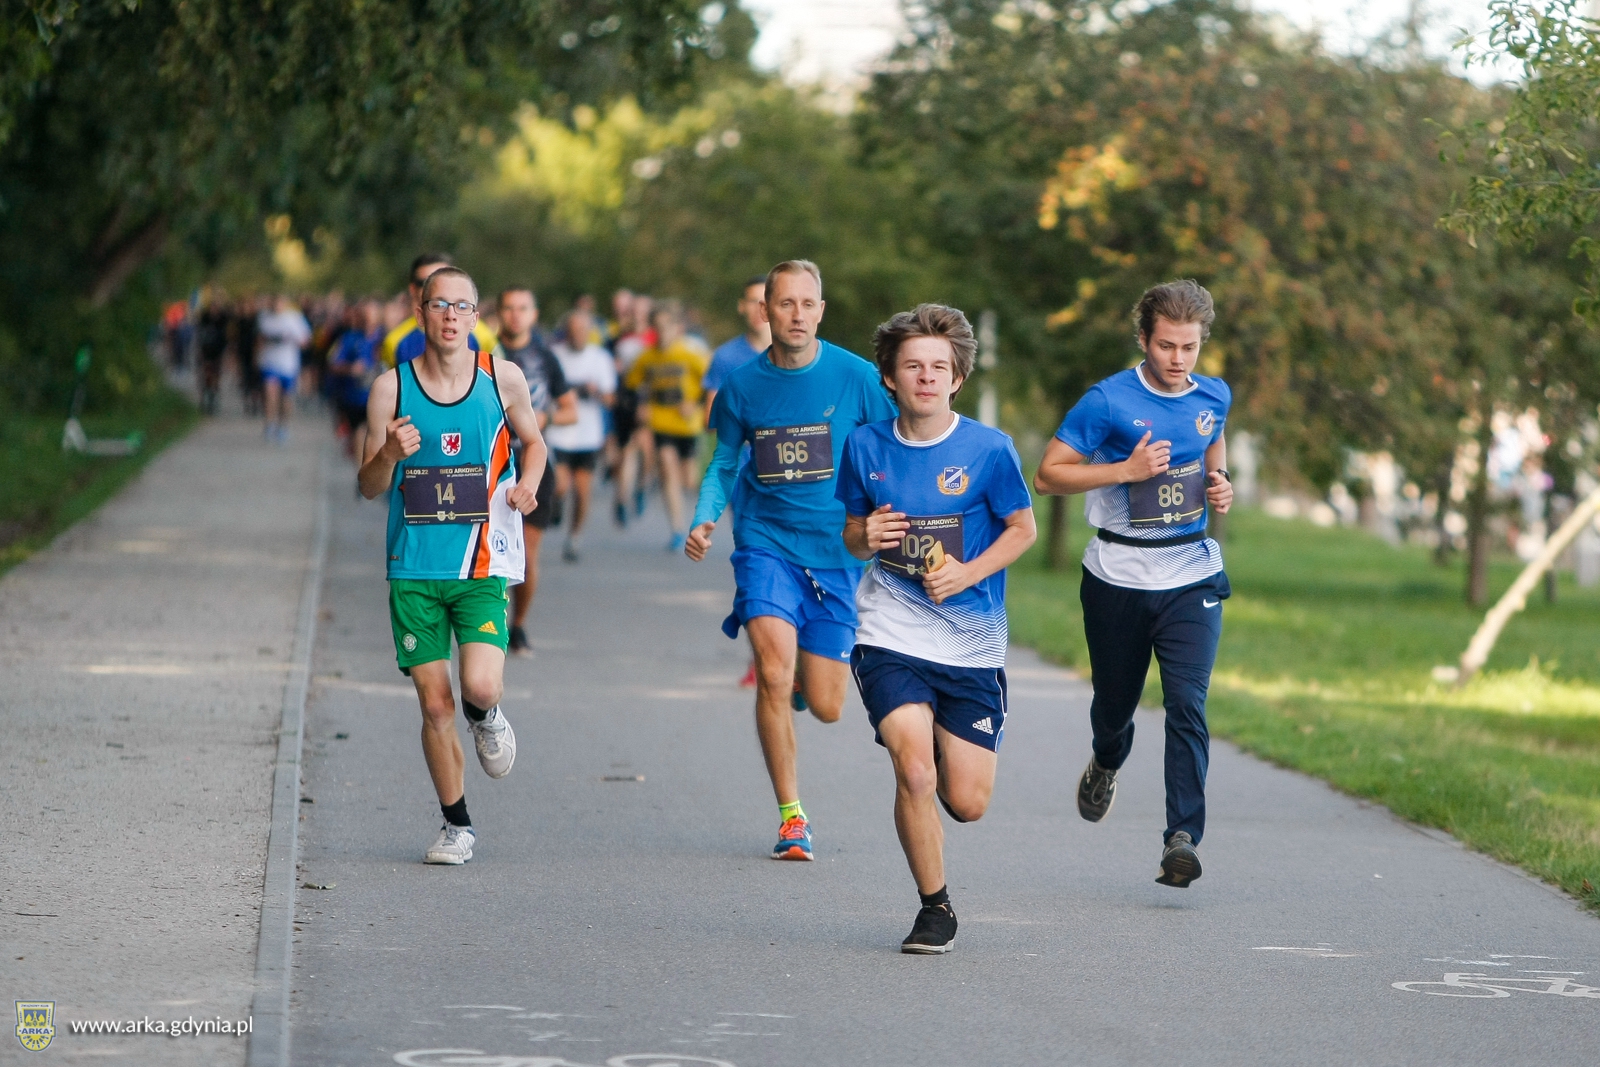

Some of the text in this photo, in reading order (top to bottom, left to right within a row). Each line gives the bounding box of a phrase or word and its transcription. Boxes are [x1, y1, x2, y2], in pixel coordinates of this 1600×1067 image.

[800, 425, 828, 433] ARKOWCA
[776, 440, 809, 464] 166
[453, 466, 483, 474] ARKOWCA
[434, 482, 456, 505] 14
[1158, 482, 1185, 508] 86
[927, 517, 959, 526] ARKOWCA
[901, 533, 935, 559] 102
[972, 722, 994, 735] adidas
